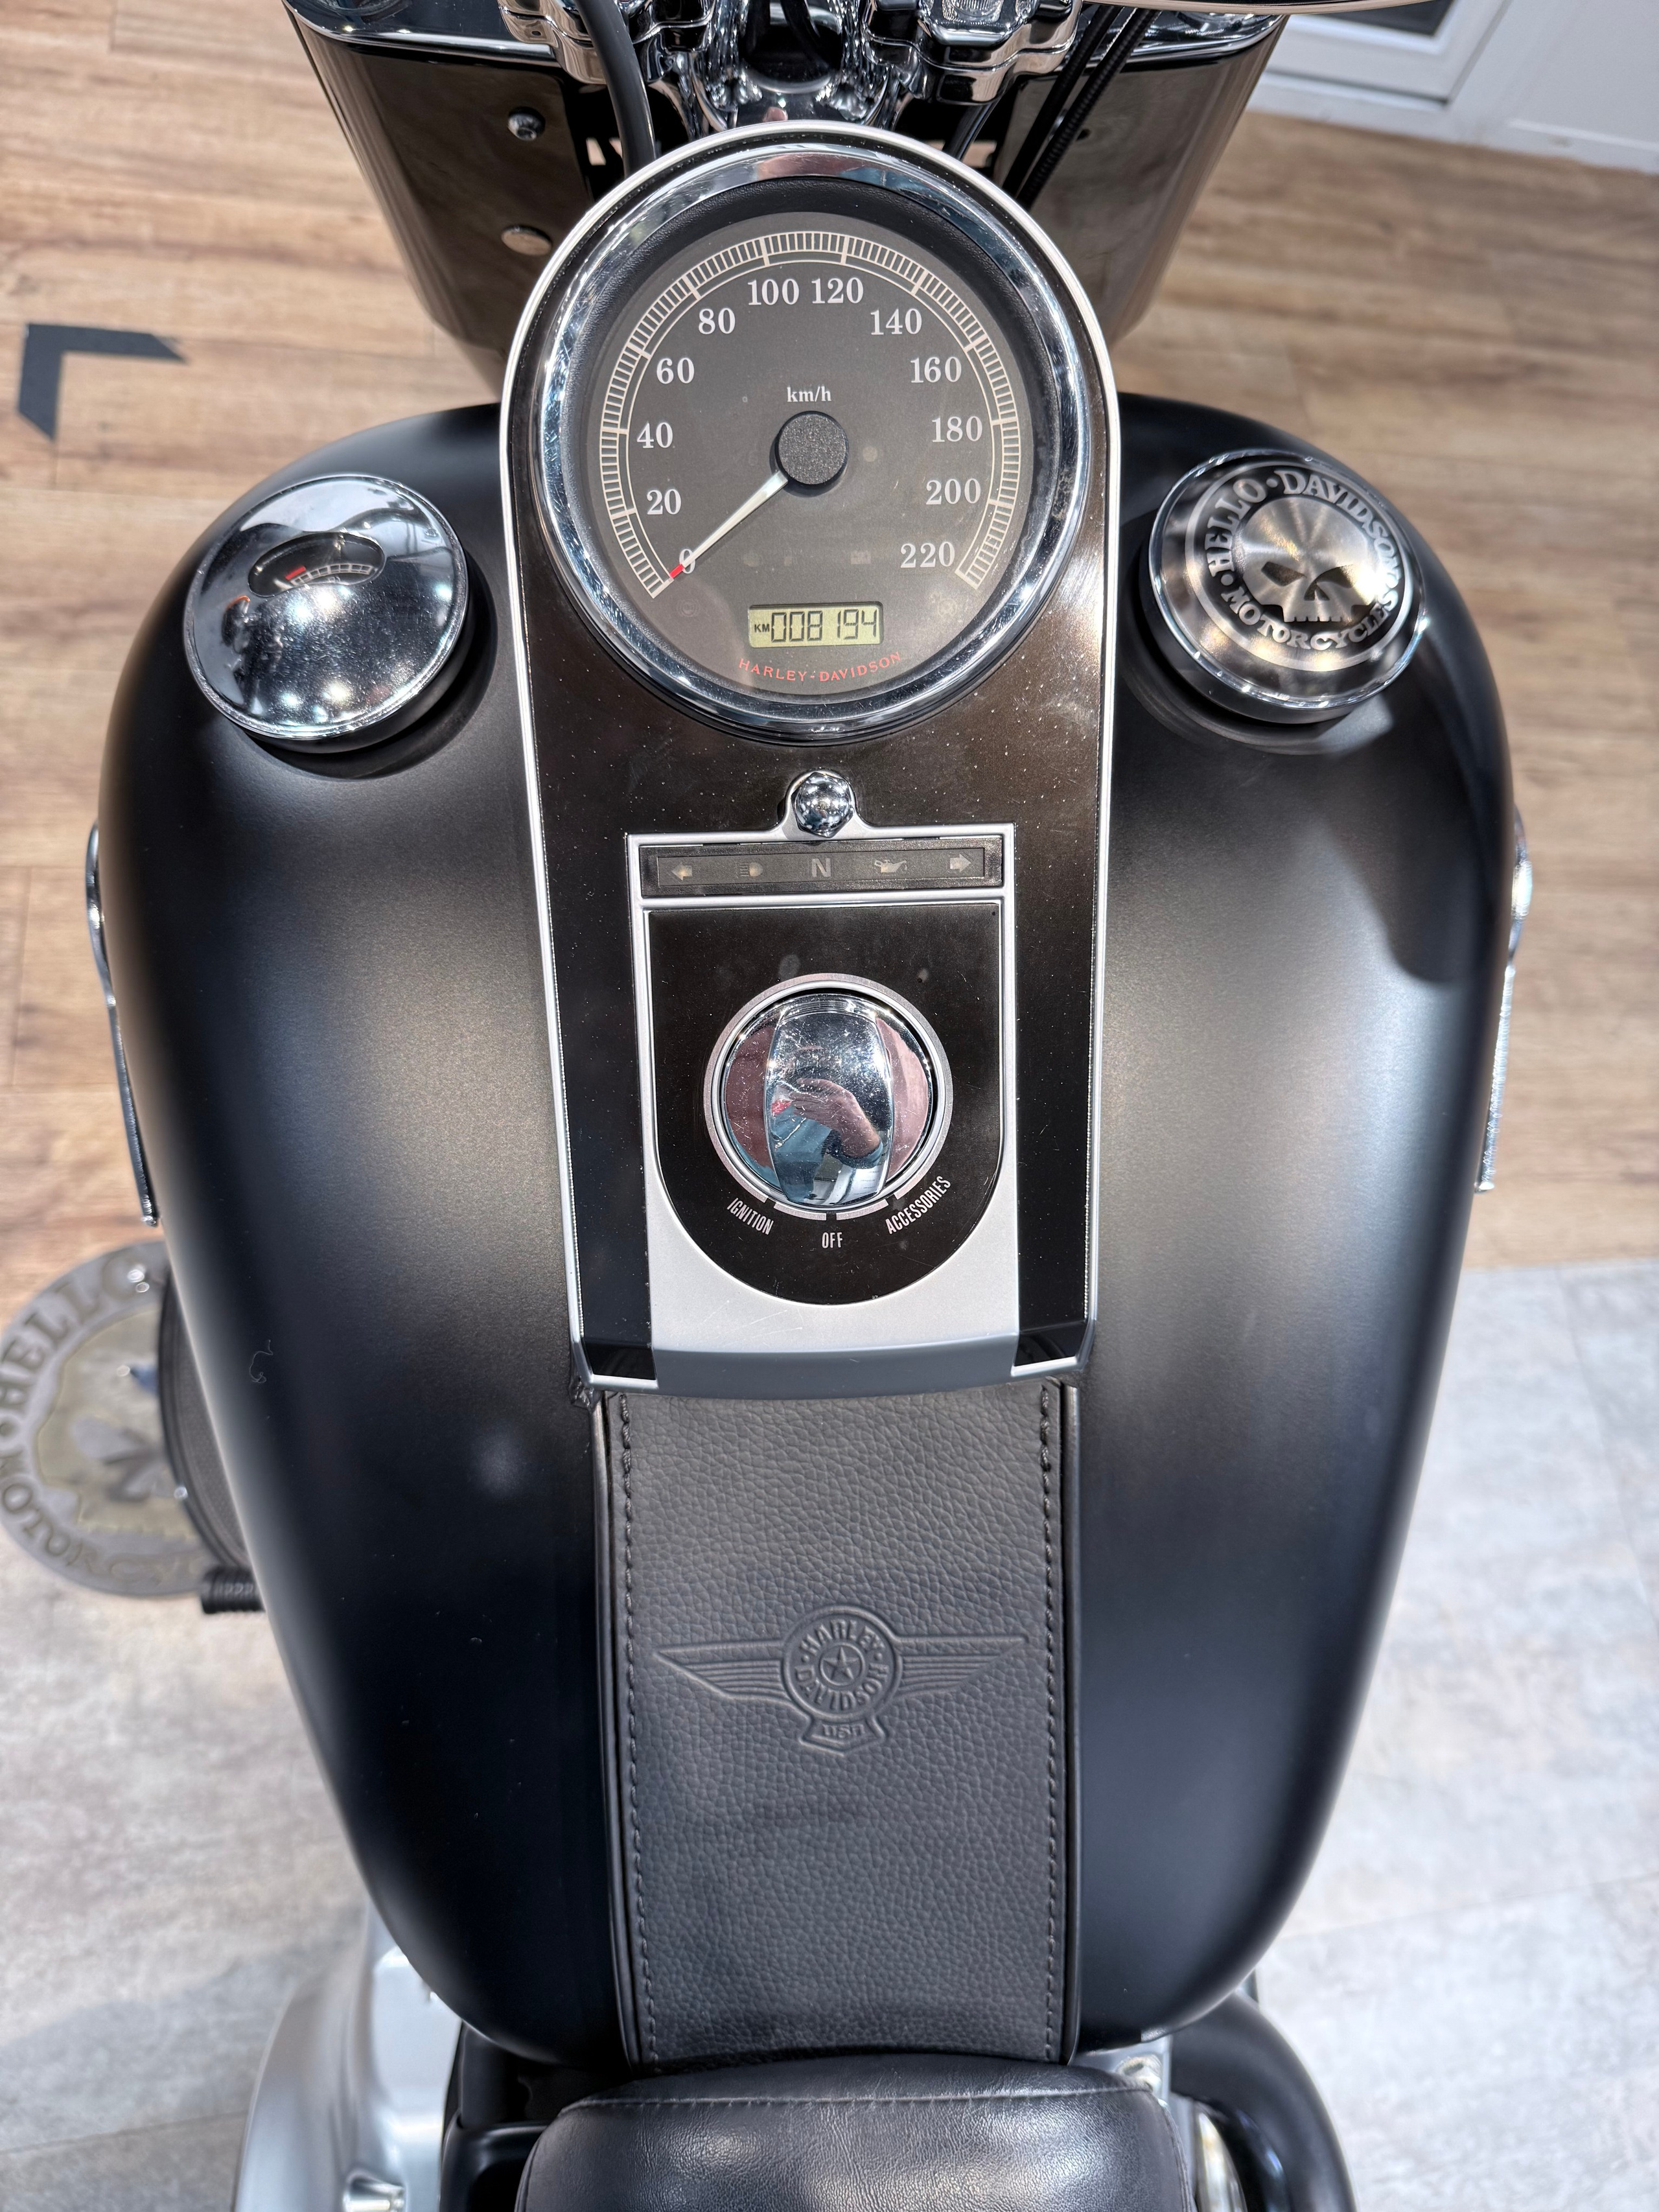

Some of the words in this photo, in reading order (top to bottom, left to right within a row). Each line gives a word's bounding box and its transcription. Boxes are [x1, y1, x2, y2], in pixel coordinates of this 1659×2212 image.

[747, 278, 800, 305] 100
[811, 277, 864, 305] 120
[697, 308, 736, 335] 80
[870, 308, 923, 336] 140
[656, 357, 695, 384] 60
[909, 356, 962, 384] 160
[786, 385, 832, 403] km/h
[636, 422, 673, 449] 40
[931, 416, 984, 443] 180
[647, 489, 681, 516] 20
[925, 478, 981, 506] 200
[1204, 478, 1266, 578] HELLO
[1273, 469, 1402, 579] DAVIDSON
[679, 548, 696, 574] 0
[899, 541, 956, 569] 220
[754, 623, 770, 633] KM
[771, 608, 877, 643] 008194
[1221, 585, 1399, 651] MOTORCYCLES
[737, 651, 901, 682] HARLEY-DAVIDSON
[811, 857, 831, 879] N
[726, 1198, 774, 1235] IGNITION
[885, 1175, 951, 1234] ACCESSORIES
[821, 1232, 843, 1249] OFF
[799, 1619, 885, 1657] HARLEY
[795, 1662, 889, 1711] DAVIDSON
